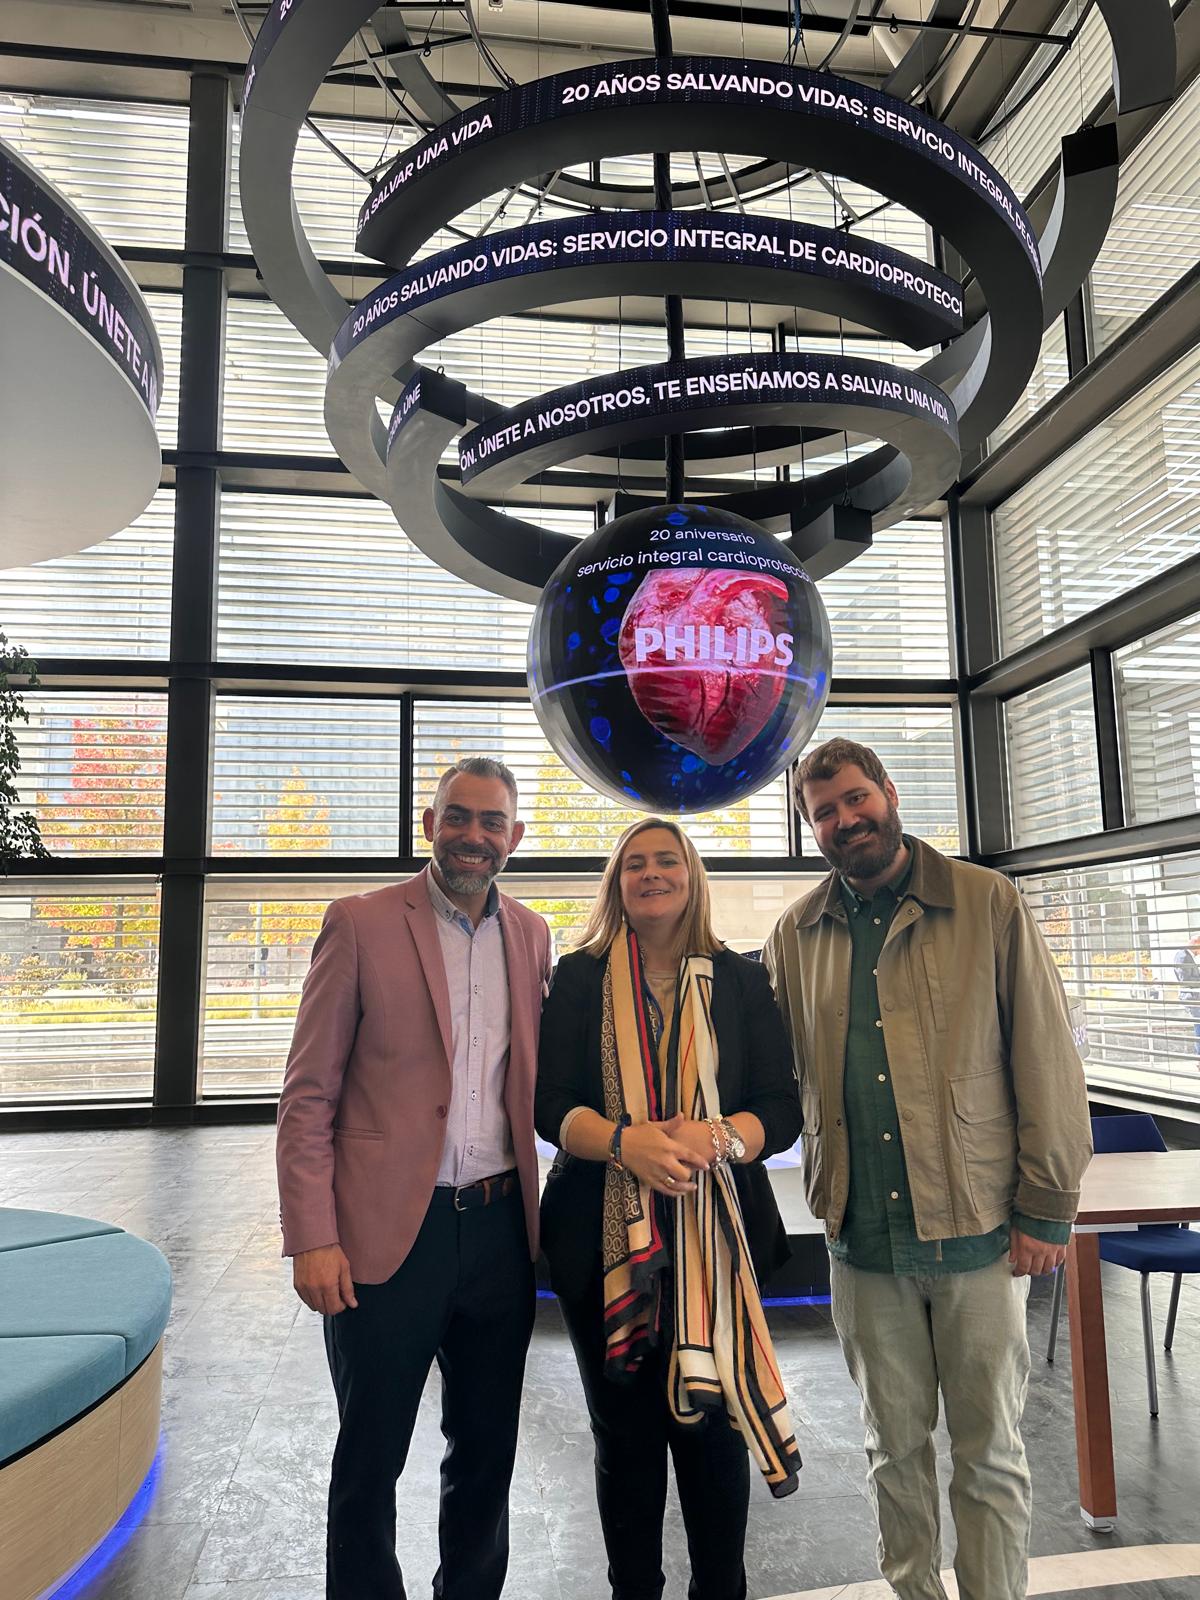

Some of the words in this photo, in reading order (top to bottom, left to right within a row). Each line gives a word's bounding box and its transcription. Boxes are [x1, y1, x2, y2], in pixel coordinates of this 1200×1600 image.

[363, 209, 370, 227] A
[371, 163, 414, 214] SALVAR
[416, 137, 449, 170] UNA
[451, 114, 493, 146] VIDA
[562, 84, 590, 104] 20
[594, 74, 661, 98] AÑOS
[667, 73, 794, 98] SALVANDO
[798, 84, 869, 119] VIDAS:
[873, 106, 955, 161] SERVICIO
[957, 152, 1015, 221] INTEGRAL
[1016, 211, 1026, 239] DE
[83, 271, 142, 379] ÚNETE
[353, 315, 365, 338] 20
[365, 292, 399, 327] AÑOS
[400, 254, 488, 302] SALVANDO
[491, 239, 558, 267] VIDAS:
[562, 229, 668, 252] SERVICIO
[674, 229, 785, 256] INTEGRAL
[789, 240, 817, 261] DE
[821, 246, 963, 317] CARDIOPROTECCI
[460, 450, 477, 471] ÓN.
[478, 423, 521, 459] ÚNETE
[523, 418, 536, 438] A
[538, 386, 650, 431] NOSOTROS,
[654, 379, 681, 401] TE
[686, 368, 820, 396] ENSEÑAMOS
[824, 372, 839, 390] A
[841, 374, 903, 401] SALVAR
[904, 385, 930, 411] UNA
[930, 397, 949, 424] VIDA
[577, 552, 634, 578] servicio
[637, 548, 702, 565] integral
[650, 529, 670, 541] 20
[675, 528, 756, 545] aniversario
[634, 625, 795, 667] PHILIPS
